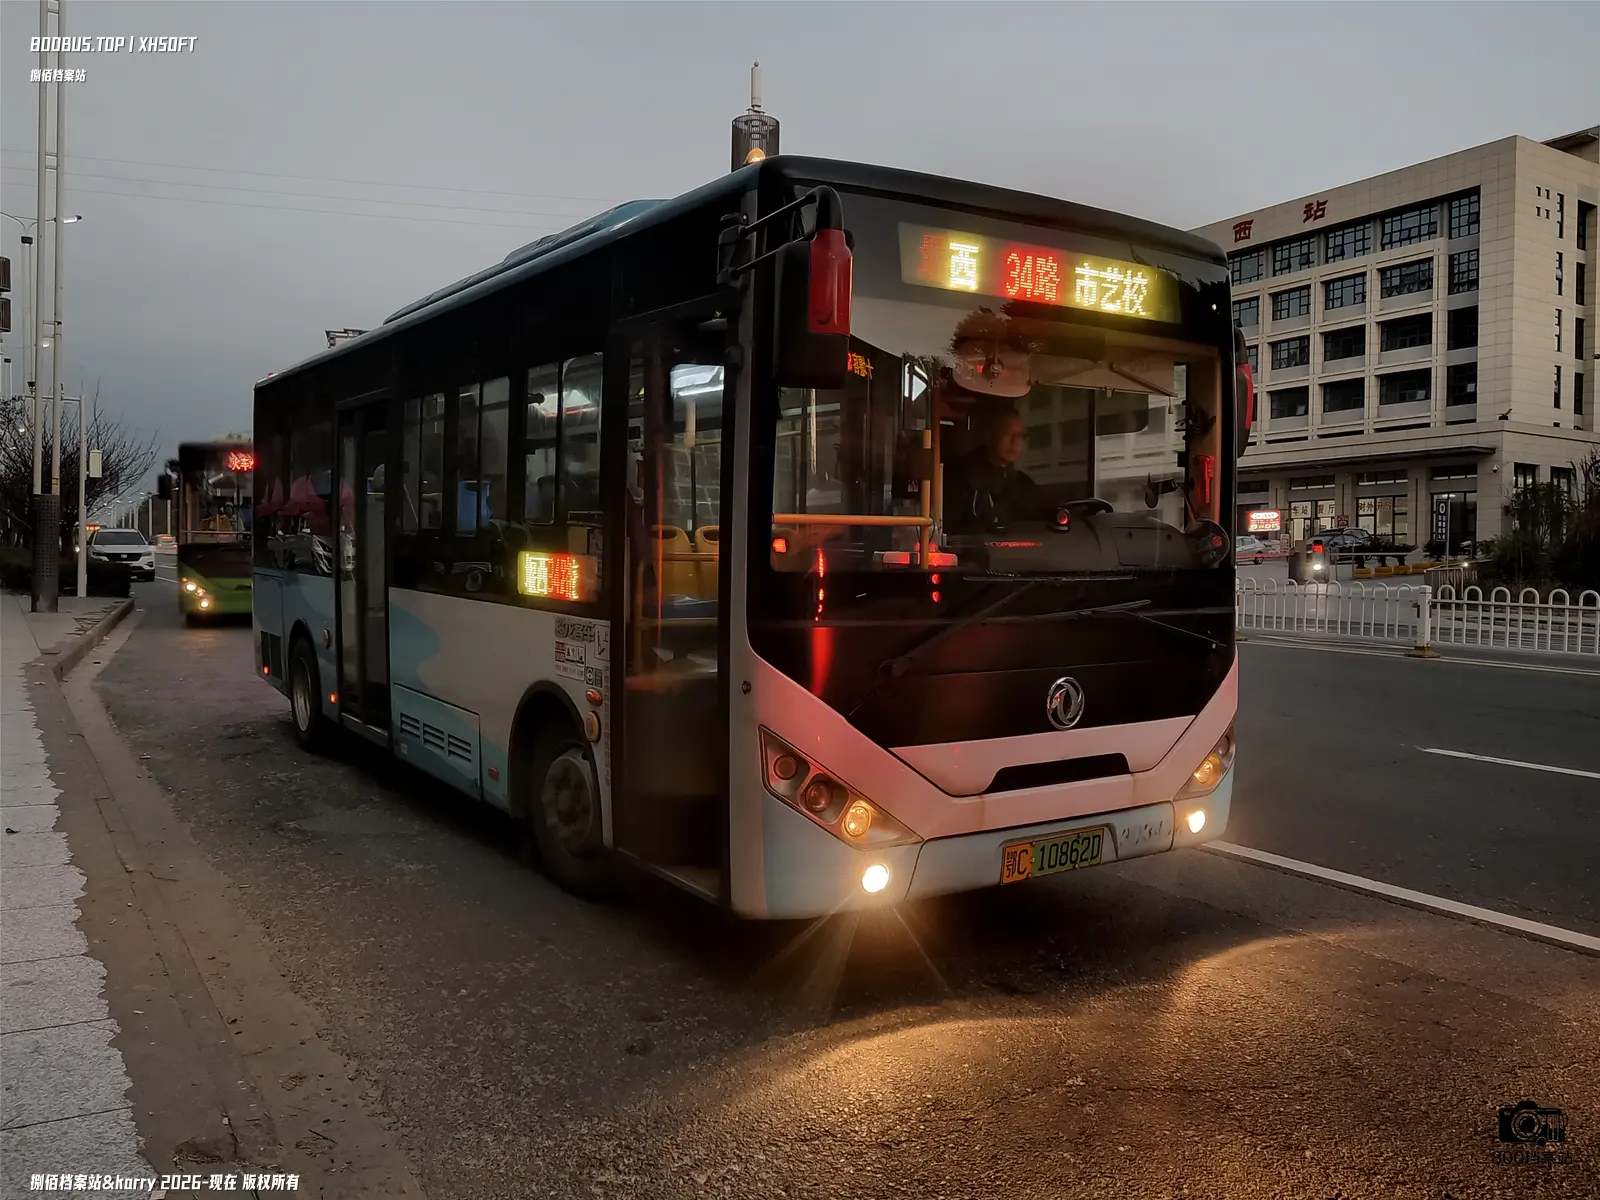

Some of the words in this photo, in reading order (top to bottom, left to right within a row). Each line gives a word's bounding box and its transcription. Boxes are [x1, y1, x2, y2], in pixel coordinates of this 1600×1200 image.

[1006, 252, 1060, 301] 34路
[1075, 262, 1149, 315] 市艺校
